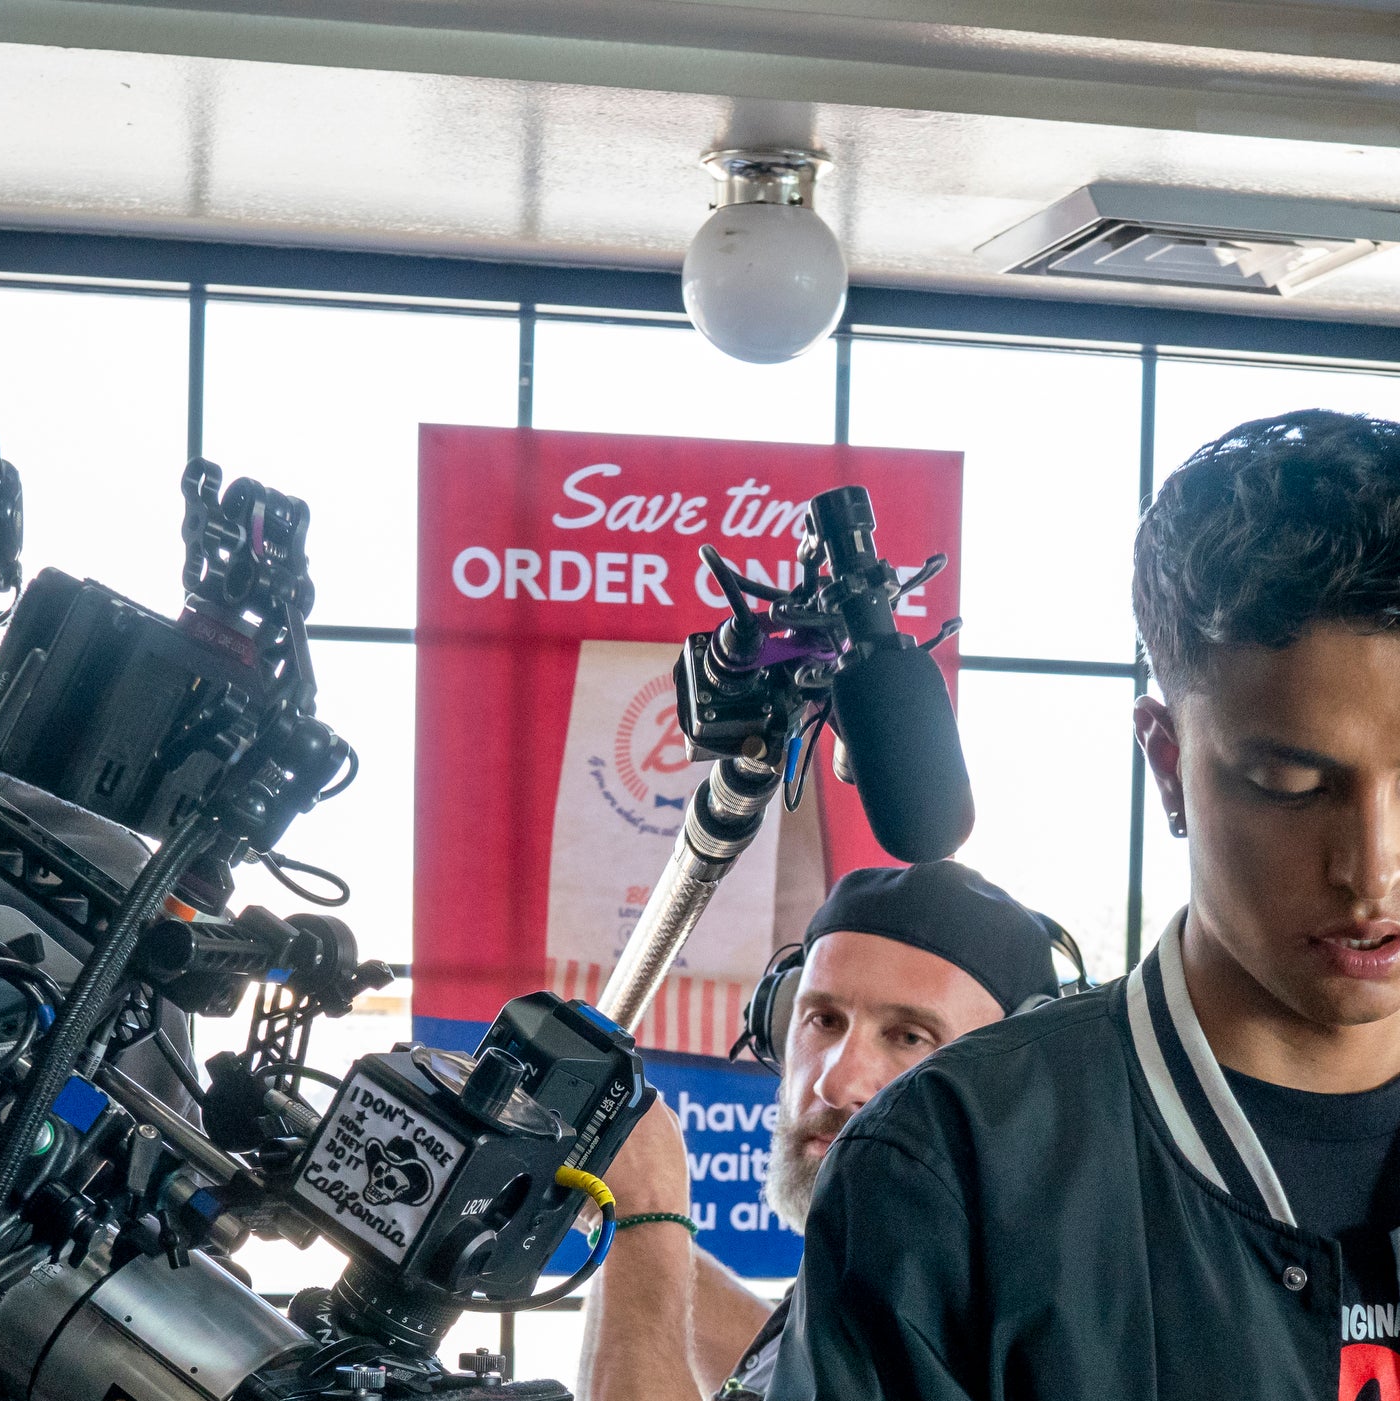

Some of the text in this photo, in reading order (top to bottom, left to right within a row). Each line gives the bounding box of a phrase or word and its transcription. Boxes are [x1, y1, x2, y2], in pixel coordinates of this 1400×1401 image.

[552, 462, 813, 538] Save tim
[452, 546, 675, 606] ORDER
[334, 1127, 365, 1154] THEY
[338, 1113, 366, 1138] HOW
[350, 1086, 455, 1169] I DON'T CARE
[325, 1137, 365, 1171] DO IT
[302, 1160, 407, 1248] California
[460, 1197, 494, 1216] LR2W
